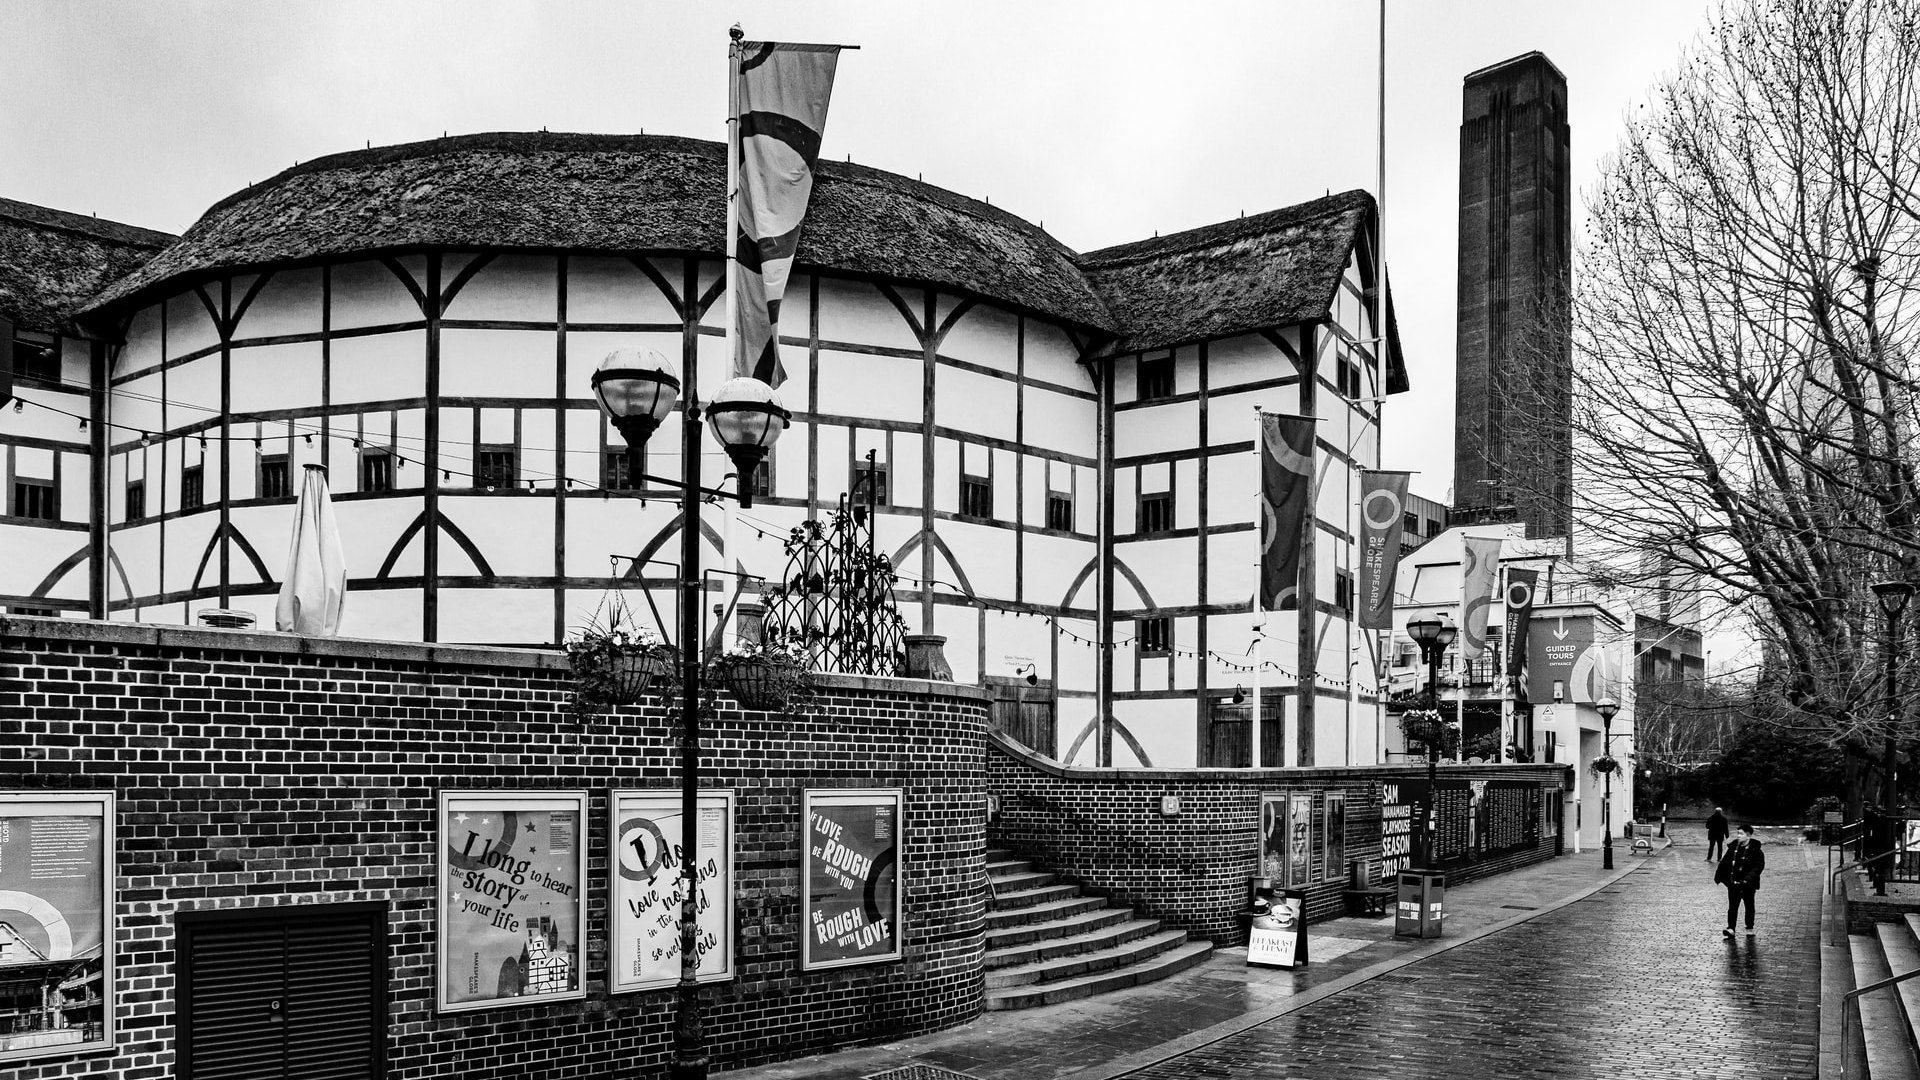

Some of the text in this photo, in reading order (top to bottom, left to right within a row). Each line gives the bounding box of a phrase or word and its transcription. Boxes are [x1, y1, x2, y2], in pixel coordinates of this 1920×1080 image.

[1365, 536, 1376, 568] GLOBE
[1369, 537, 1386, 612] SHAKESPEARE'S
[1545, 645, 1576, 653] GUIDED
[1383, 784, 1398, 804] SAM
[809, 810, 843, 842] IF LOVE
[1382, 819, 1411, 835] PLAYHOUSE
[630, 834, 658, 886] I
[812, 838, 873, 881] BE ROUGH
[1382, 834, 1411, 857] SEASON
[462, 830, 573, 896] I long to hear
[824, 864, 855, 890] WITH YOU
[450, 867, 529, 909] the story of
[628, 889, 660, 919] love
[461, 899, 519, 933] your life
[647, 928, 658, 938] in
[656, 914, 674, 928] the
[812, 909, 824, 924] BE
[816, 907, 863, 945] ROUGH
[837, 918, 890, 950] WITH LOVE
[652, 948, 663, 961] so
